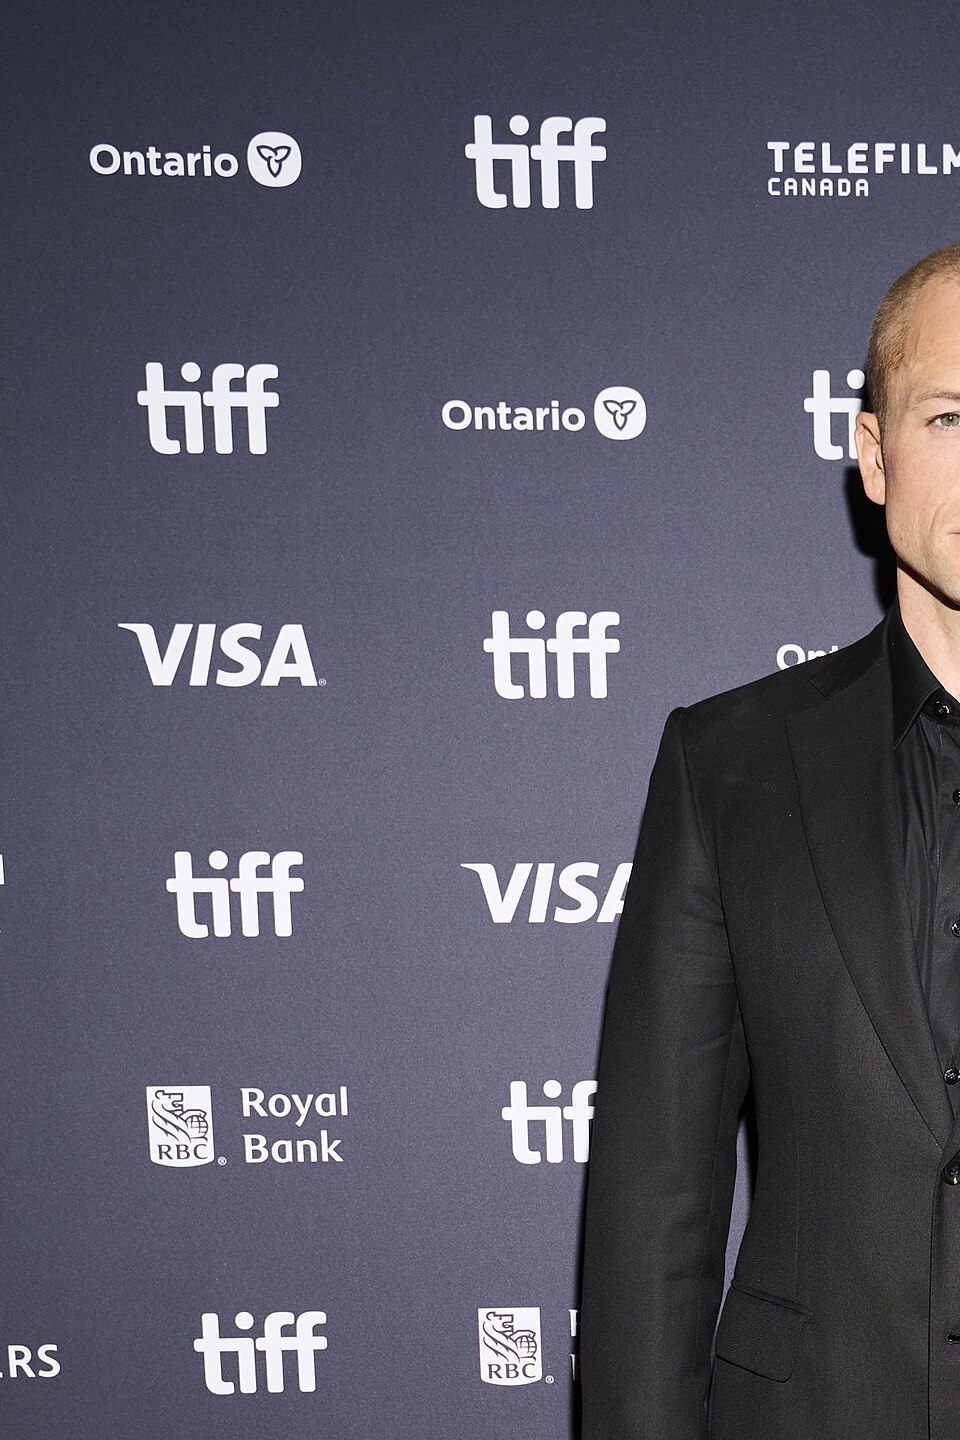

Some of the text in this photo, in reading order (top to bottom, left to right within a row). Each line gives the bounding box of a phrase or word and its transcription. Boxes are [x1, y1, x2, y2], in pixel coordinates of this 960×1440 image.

[90, 144, 238, 177] Ontario
[465, 115, 606, 209] tiff
[768, 178, 868, 196] CANADA
[137, 362, 279, 454] tiff
[442, 400, 585, 431] Ontario
[118, 623, 317, 687] VISA
[483, 610, 620, 699] tiff
[166, 851, 304, 938] tiff
[240, 1086, 348, 1127] Royal
[501, 1079, 598, 1165] tif
[158, 1144, 207, 1159] RBC
[243, 1130, 343, 1163] Bank
[194, 1311, 327, 1395] tiff
[488, 1363, 535, 1378] RBC
